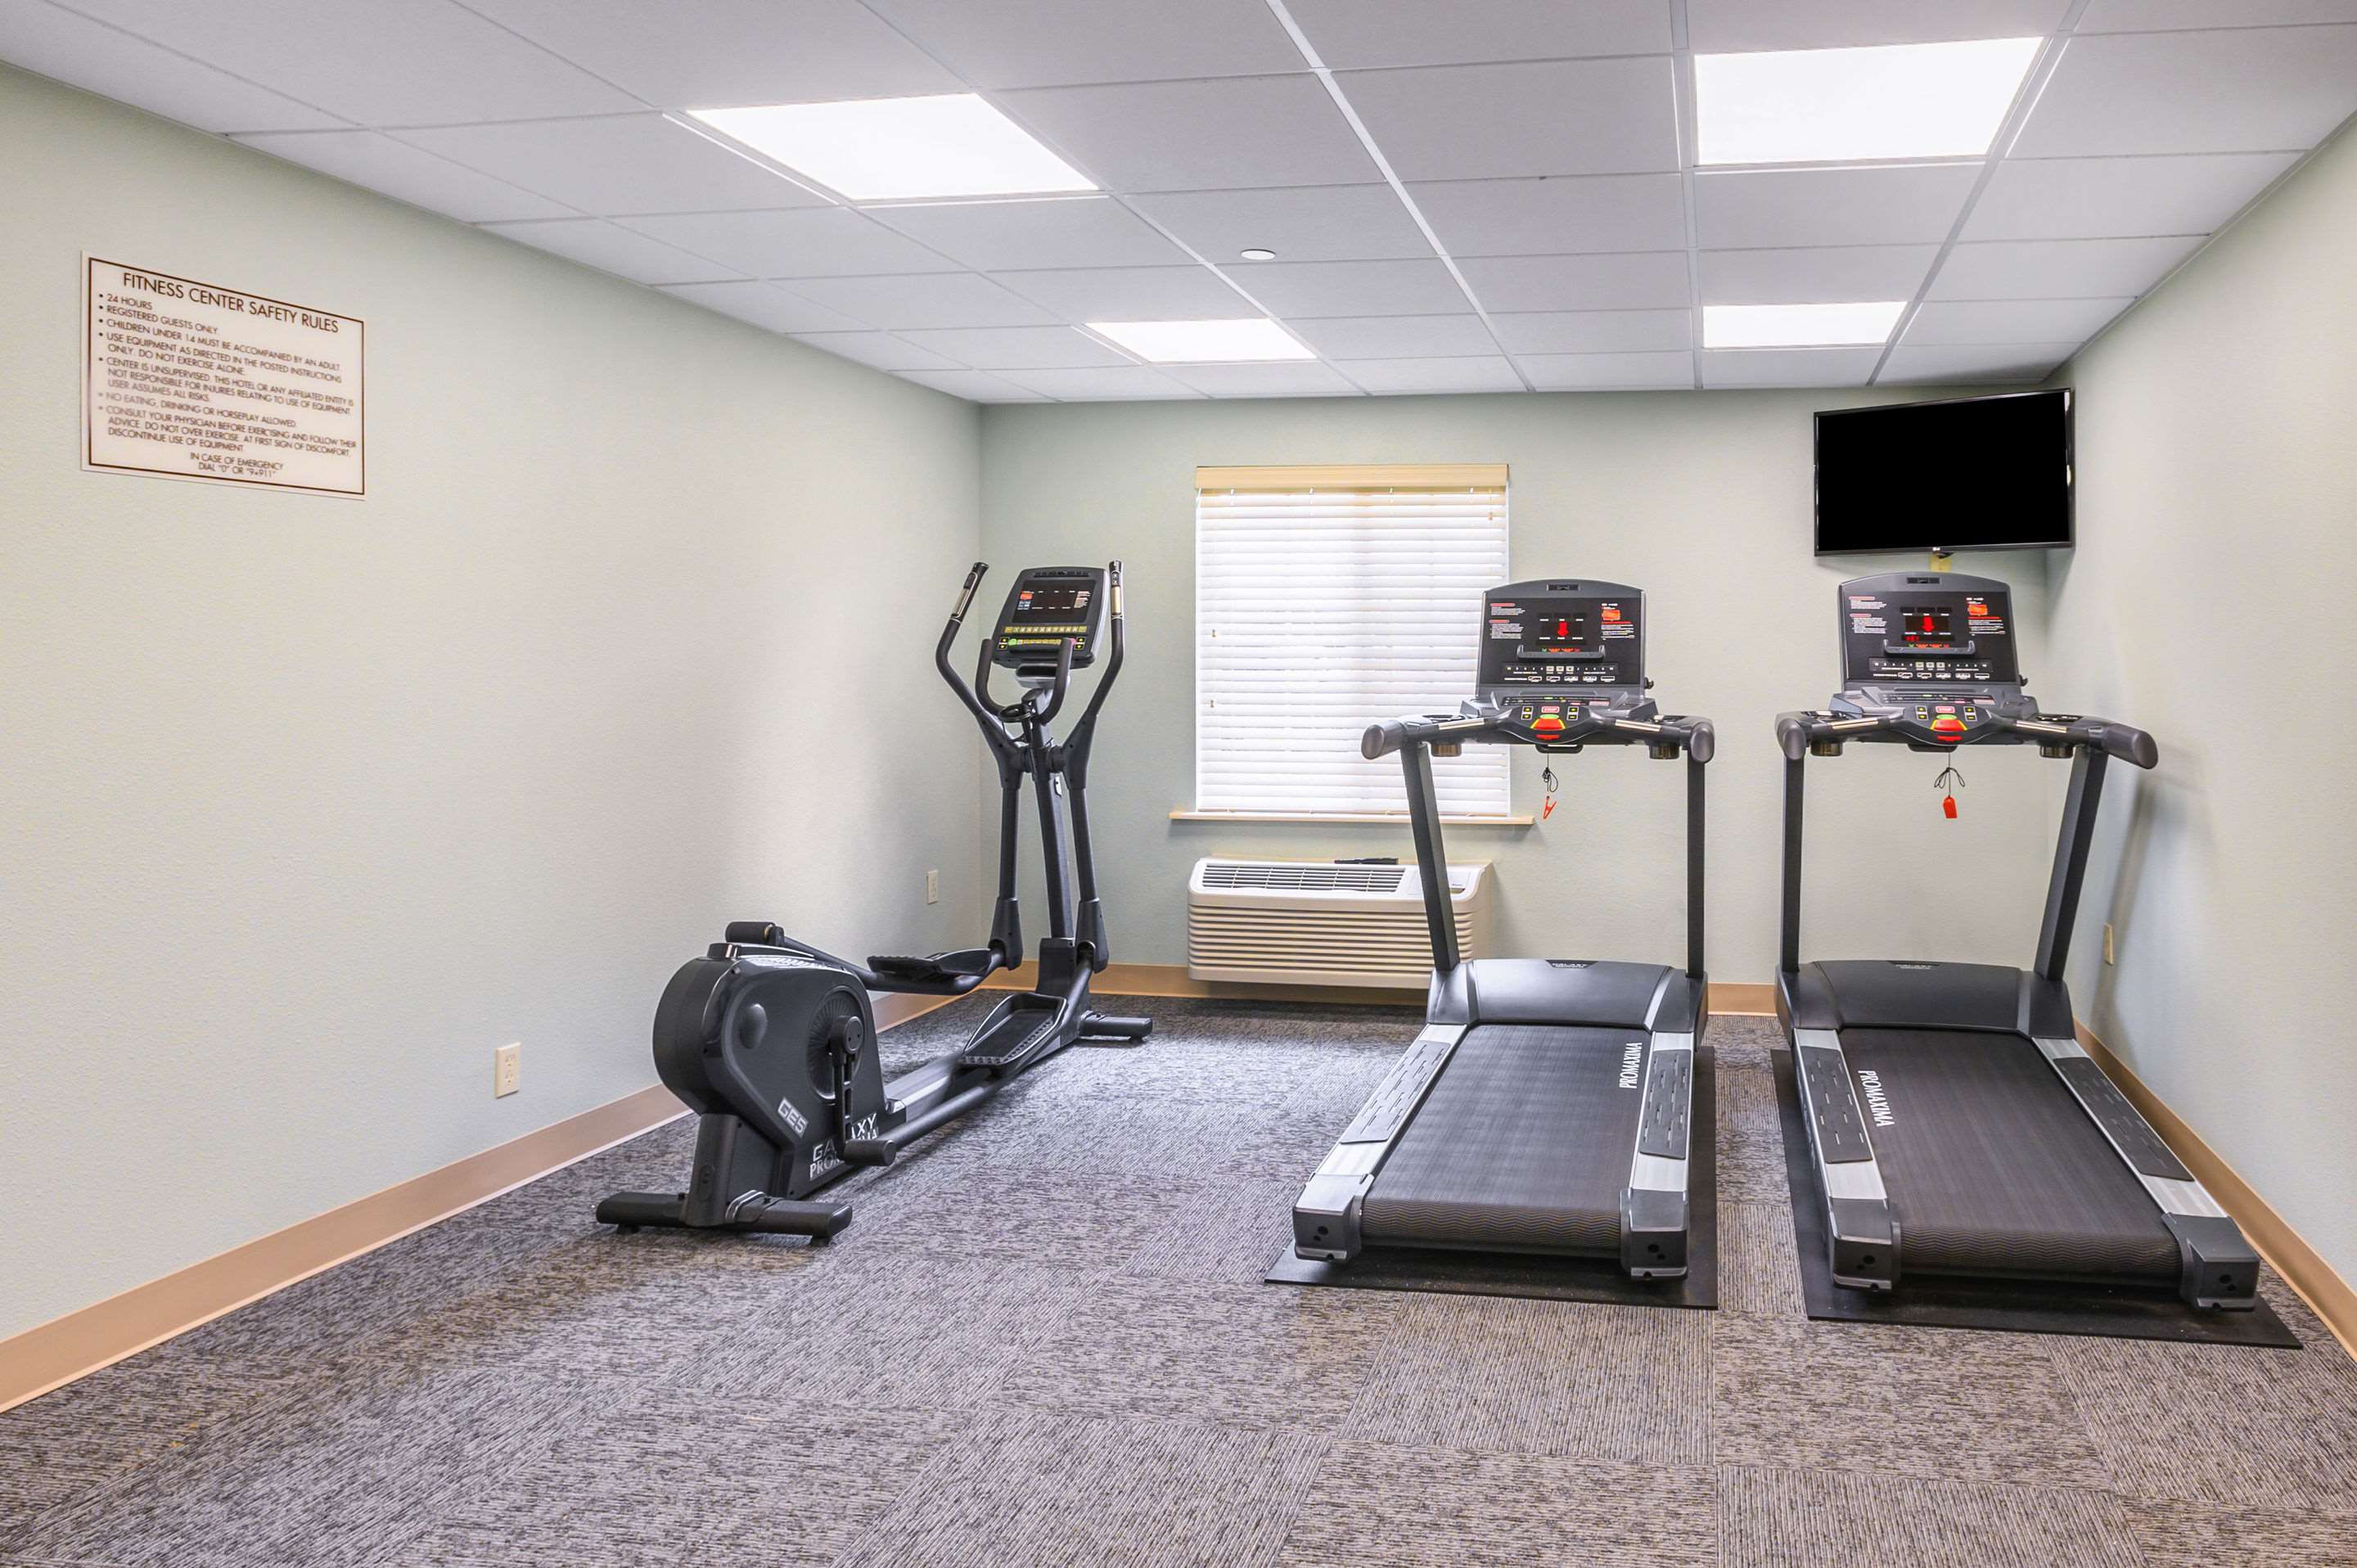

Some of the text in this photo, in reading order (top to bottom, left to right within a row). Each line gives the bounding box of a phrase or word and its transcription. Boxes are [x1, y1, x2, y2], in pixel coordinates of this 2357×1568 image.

[107, 293, 152, 310] 24 HOURS
[124, 273, 339, 332] FITNESS CENTER SAFETY RULES
[107, 305, 158, 322] REGISTERED
[160, 316, 193, 330] GUESTS
[106, 318, 150, 334] CHILDREN
[152, 327, 182, 340] UNDER
[186, 334, 196, 342] 14
[197, 336, 219, 347] MUST
[222, 341, 231, 349] BE
[234, 344, 291, 361] ACCOMPANIED
[295, 355, 302, 363] BY
[304, 358, 317, 366] AN
[106, 331, 124, 341] USE
[127, 336, 176, 352] EQUIPMENT
[181, 346, 191, 354] AS
[193, 349, 230, 362] DIRECTED
[245, 358, 257, 367] THE
[260, 361, 288, 372] POSTED
[291, 367, 341, 382] INSTRUCTIONS
[138, 349, 153, 358] DO
[155, 352, 174, 362] NOT
[178, 356, 214, 369] EXERCISE
[106, 357, 139, 369] CENTER
[214, 376, 230, 385] THIS
[232, 379, 255, 389] HOTEL
[270, 385, 286, 394] ANY
[288, 389, 323, 401] AFFILIATED
[326, 395, 346, 405] ENTITY
[108, 368, 127, 378] NOT
[130, 372, 183, 387] RESPONSIBLE
[185, 381, 201, 390] FOR
[203, 385, 235, 395] INJURIES
[237, 390, 272, 402] RELATING
[108, 379, 128, 389] USER
[132, 383, 171, 395] ASSUMES
[174, 390, 186, 398] ALL
[106, 392, 121, 401] NO
[160, 400, 201, 412] DRINKING
[203, 407, 215, 415] OR
[217, 409, 259, 421] HORSEPLAY
[106, 405, 146, 417] CONSULT
[149, 412, 171, 421] YOUR
[174, 415, 216, 427] PHYSICIAN
[219, 422, 246, 432] BEFORE
[248, 426, 290, 438] EXERCISING
[309, 435, 338, 445] FOLLOW
[108, 427, 166, 442] DISCONTINUE
[169, 435, 183, 444] USE
[186, 438, 197, 446] OF
[145, 421, 158, 430] DO
[160, 424, 178, 433] NOT
[182, 427, 203, 436] OVER
[255, 437, 273, 446] FIRST
[275, 440, 292, 448] SIGN
[198, 462, 215, 471] DIAL
[201, 454, 222, 462] CASE
[237, 458, 283, 470] EMERGENCY
[1619, 1042, 1643, 1089] PROMAXIMA
[1858, 1070, 1895, 1127] PROMAXIMA
